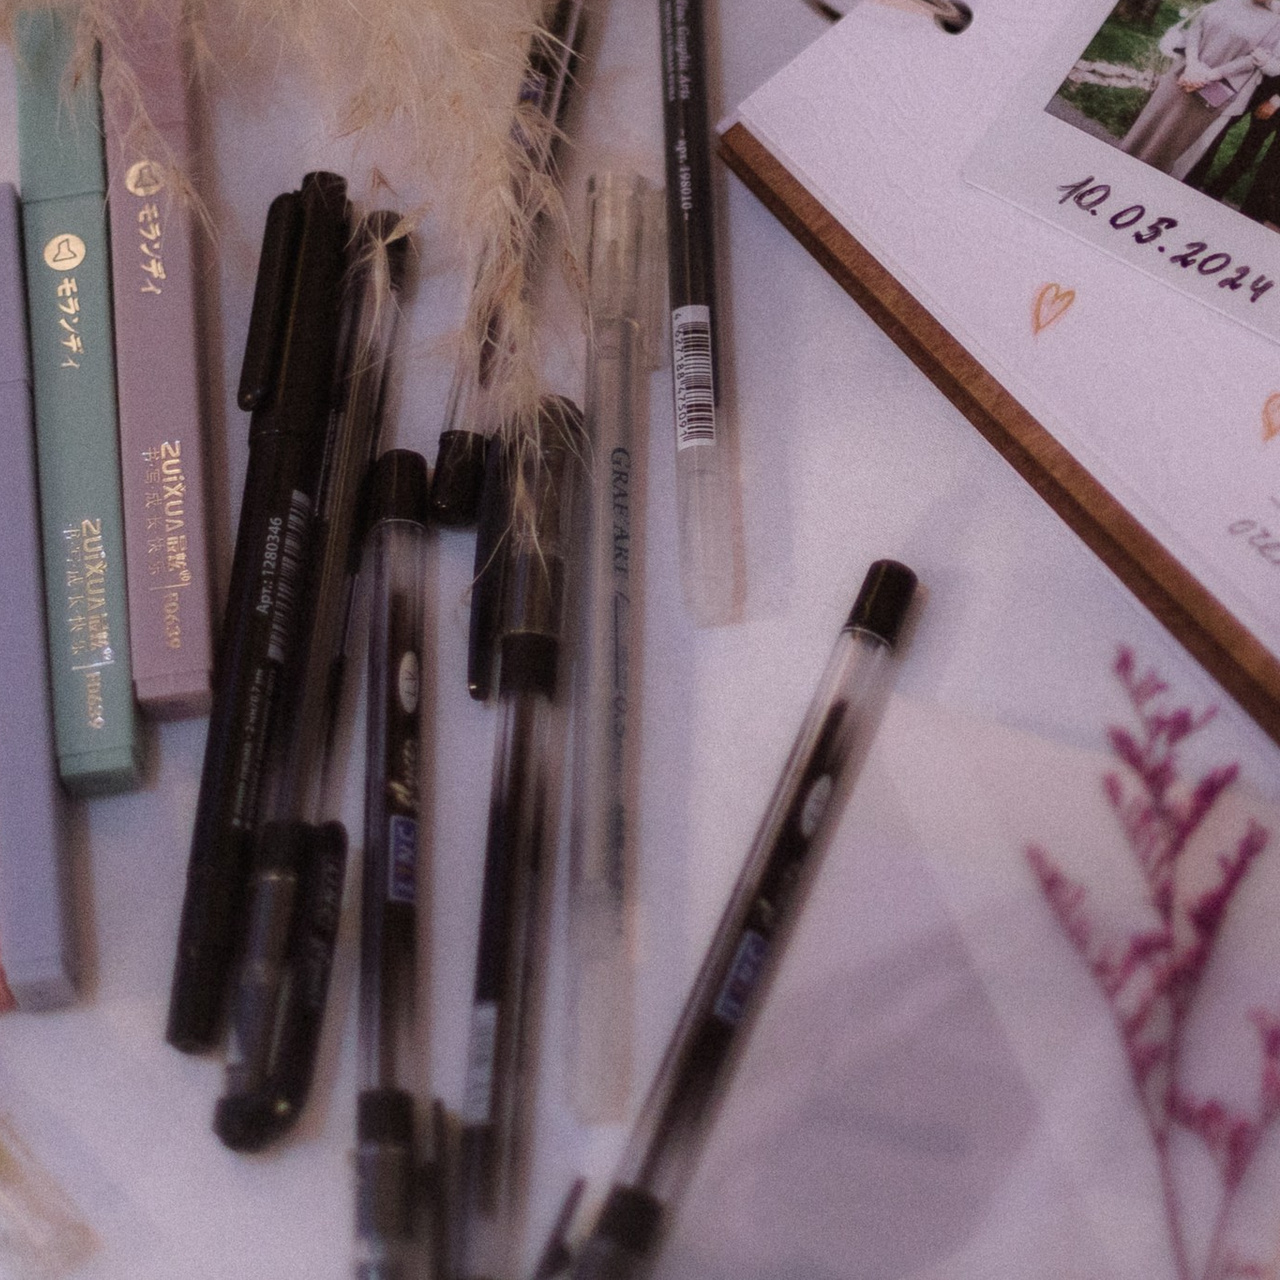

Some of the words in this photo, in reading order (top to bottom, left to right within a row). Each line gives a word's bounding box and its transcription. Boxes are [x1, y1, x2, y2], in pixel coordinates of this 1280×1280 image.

[138, 203, 166, 295] モランディ
[1057, 175, 1275, 303] 10.05.2024
[55, 277, 85, 370] モランディ
[261, 516, 283, 575] 1280346
